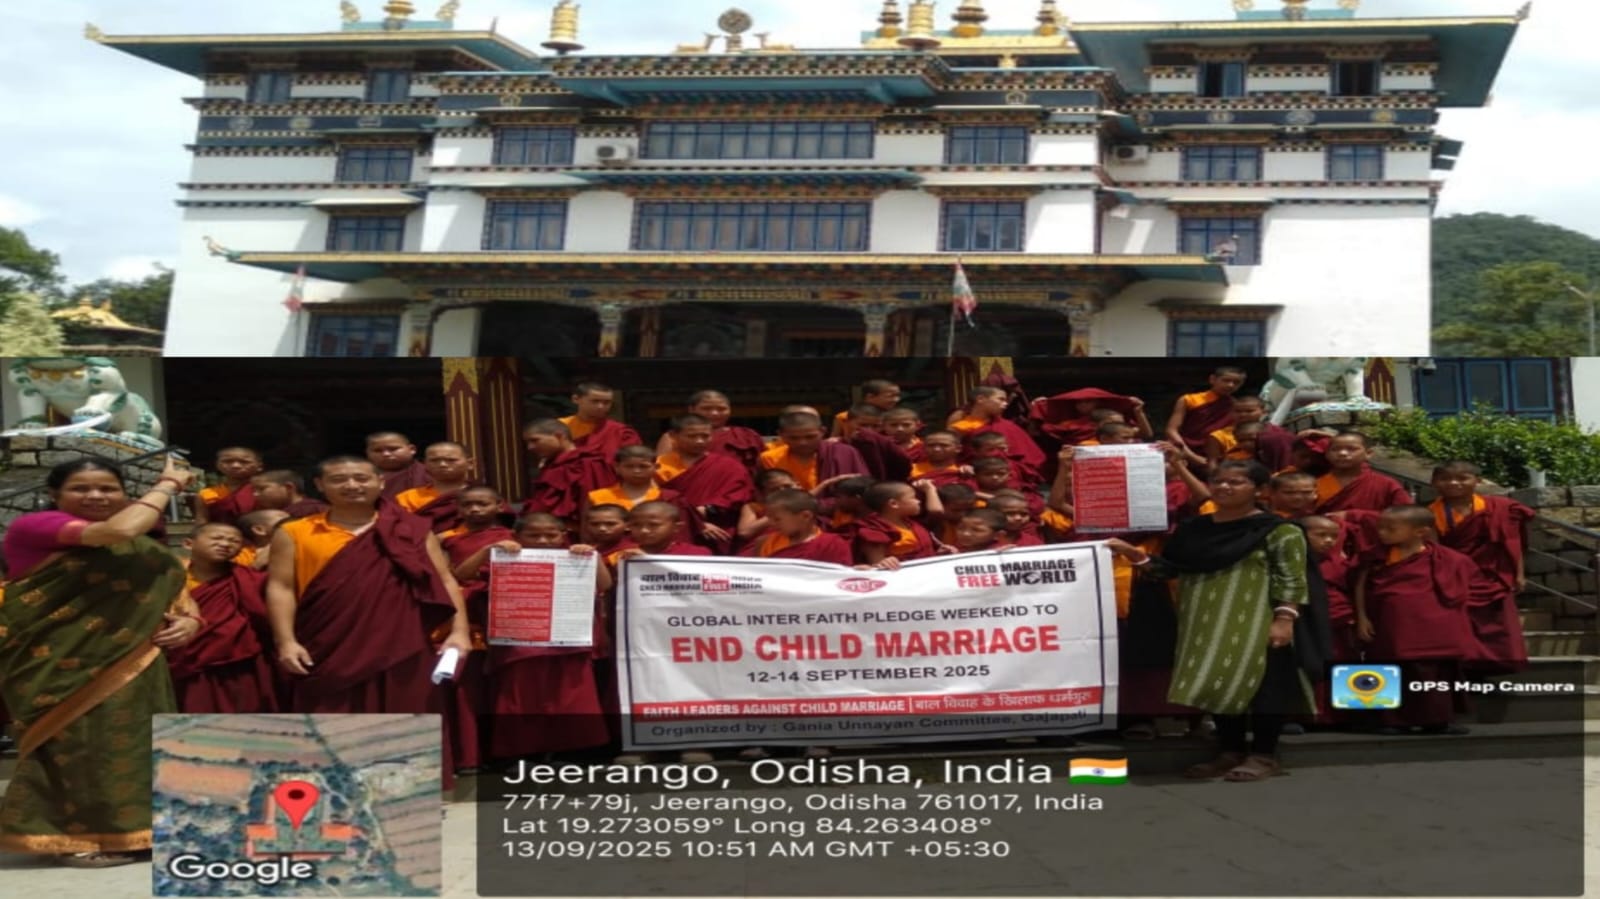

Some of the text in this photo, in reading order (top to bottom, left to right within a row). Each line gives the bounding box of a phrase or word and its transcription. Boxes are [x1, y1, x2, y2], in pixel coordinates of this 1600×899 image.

[954, 559, 1076, 575] CHILD MARRIAGE
[957, 570, 1077, 588] FREE WORLD
[667, 604, 1059, 628] GLOBAL INTER FAITH PLEDGE WEEKEND TO
[671, 625, 1060, 664] END CHILD MARRIAGE
[747, 665, 990, 683] 12-14 SEPTEMBER 2025
[643, 700, 905, 717] FAITH LEADERS AGAINST CHILD MARRIAGE
[652, 725, 740, 737] Organized
[746, 723, 766, 734] by
[783, 721, 833, 732] Gania
[838, 720, 914, 731] Unnayan
[919, 714, 1016, 728] Committee,
